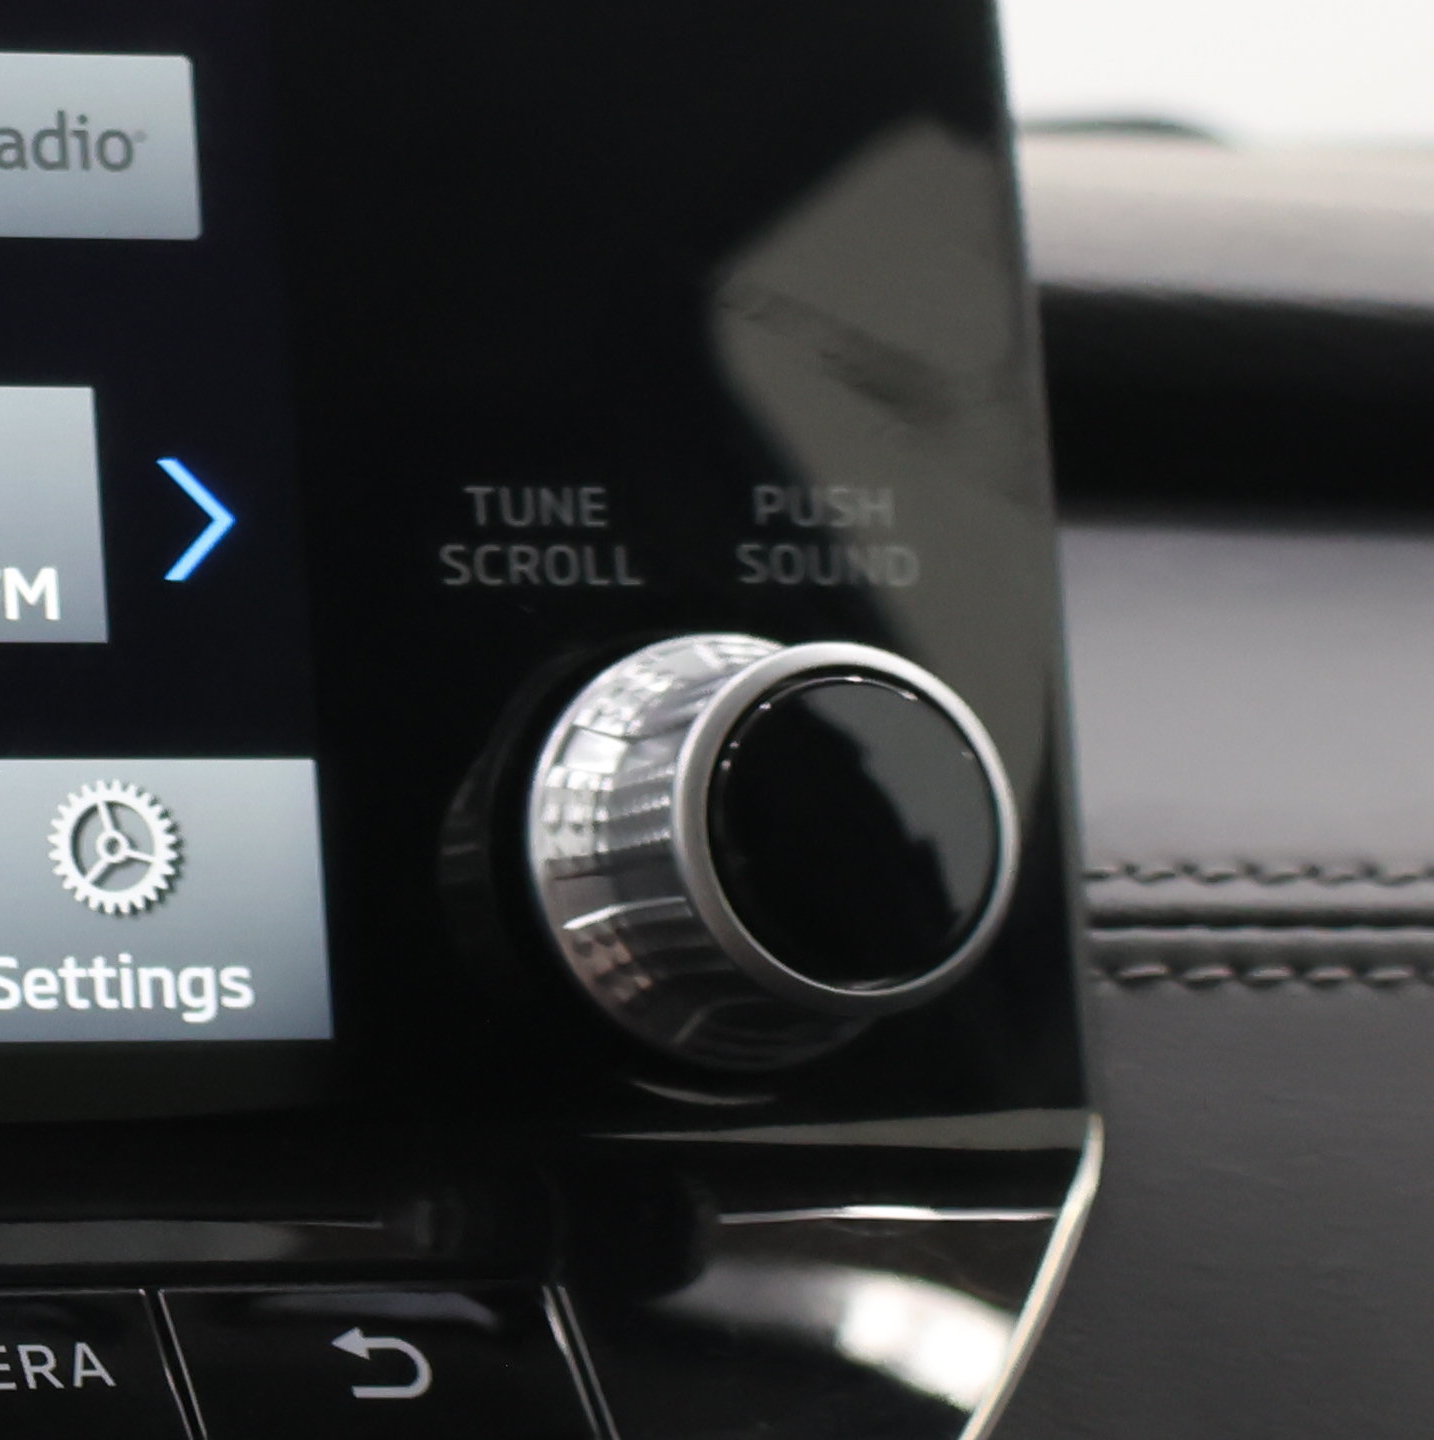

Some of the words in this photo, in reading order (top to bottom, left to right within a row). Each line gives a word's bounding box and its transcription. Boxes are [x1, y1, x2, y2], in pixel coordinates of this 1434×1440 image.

[464, 486, 608, 528] TUNE
[752, 486, 896, 529] PUSH
[439, 544, 645, 587] SCROLL
[734, 544, 920, 588] SOUND
